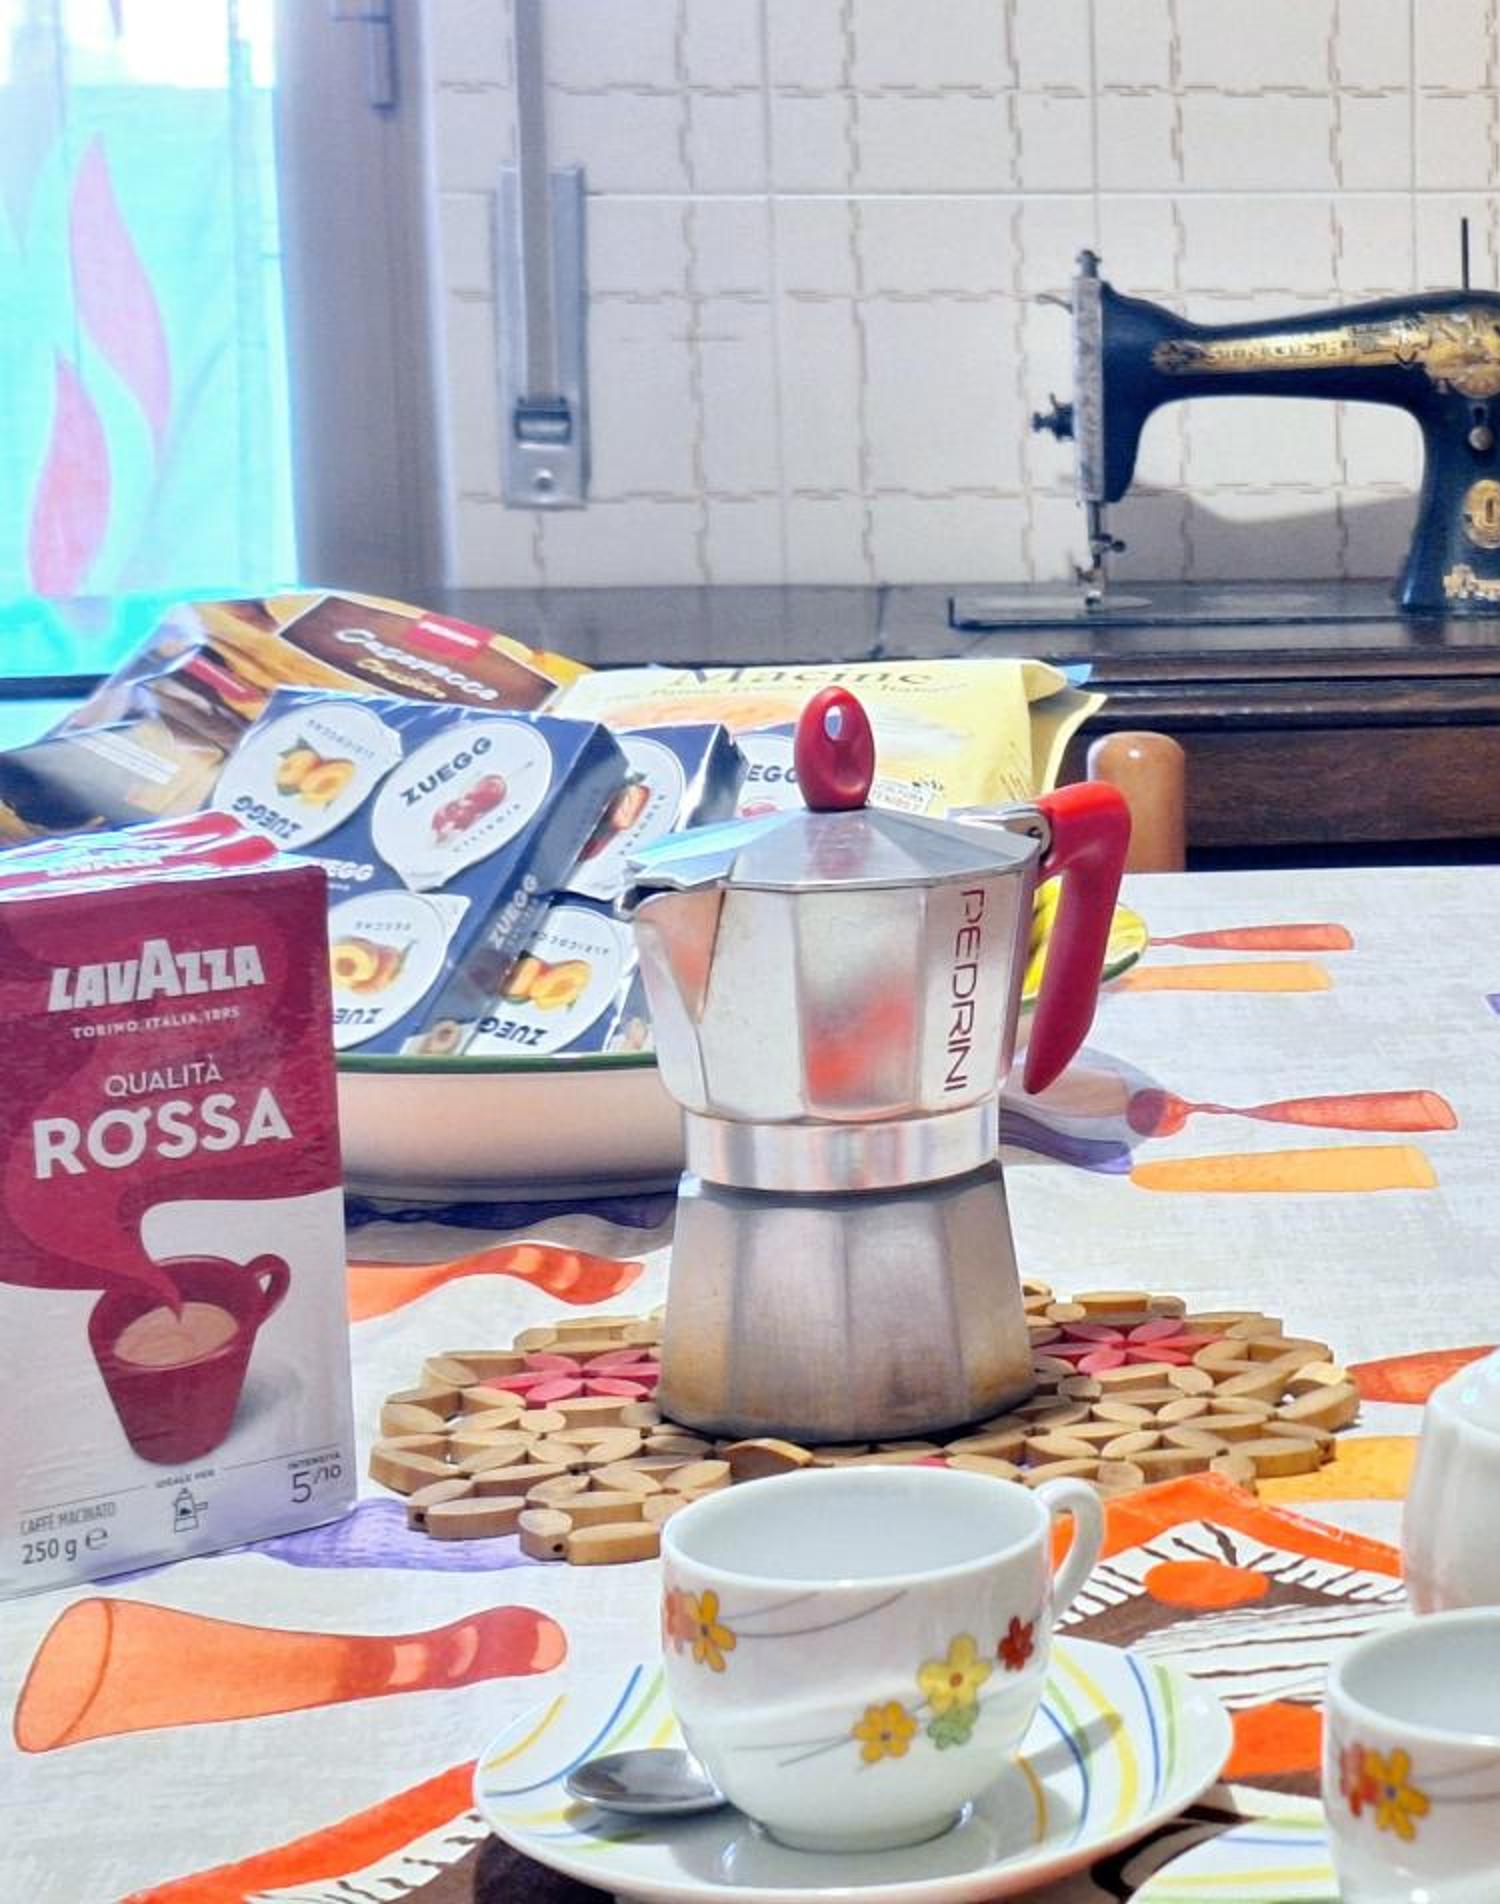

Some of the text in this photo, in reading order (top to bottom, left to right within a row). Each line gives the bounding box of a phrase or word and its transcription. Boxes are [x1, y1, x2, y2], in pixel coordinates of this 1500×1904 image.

[402, 736, 492, 807] ZUEGG
[231, 795, 303, 839] ZUEGG
[48, 938, 266, 1013] LAVAZZA
[943, 889, 985, 1092] PEDRINI
[331, 1008, 383, 1025] ZUE
[478, 1017, 549, 1047] ZUEG
[104, 1054, 224, 1098] QUALITÀ
[33, 1087, 294, 1179] ROSSA
[289, 1463, 342, 1503] 5/10
[21, 1538, 60, 1565] 250
[65, 1538, 77, 1562] g
